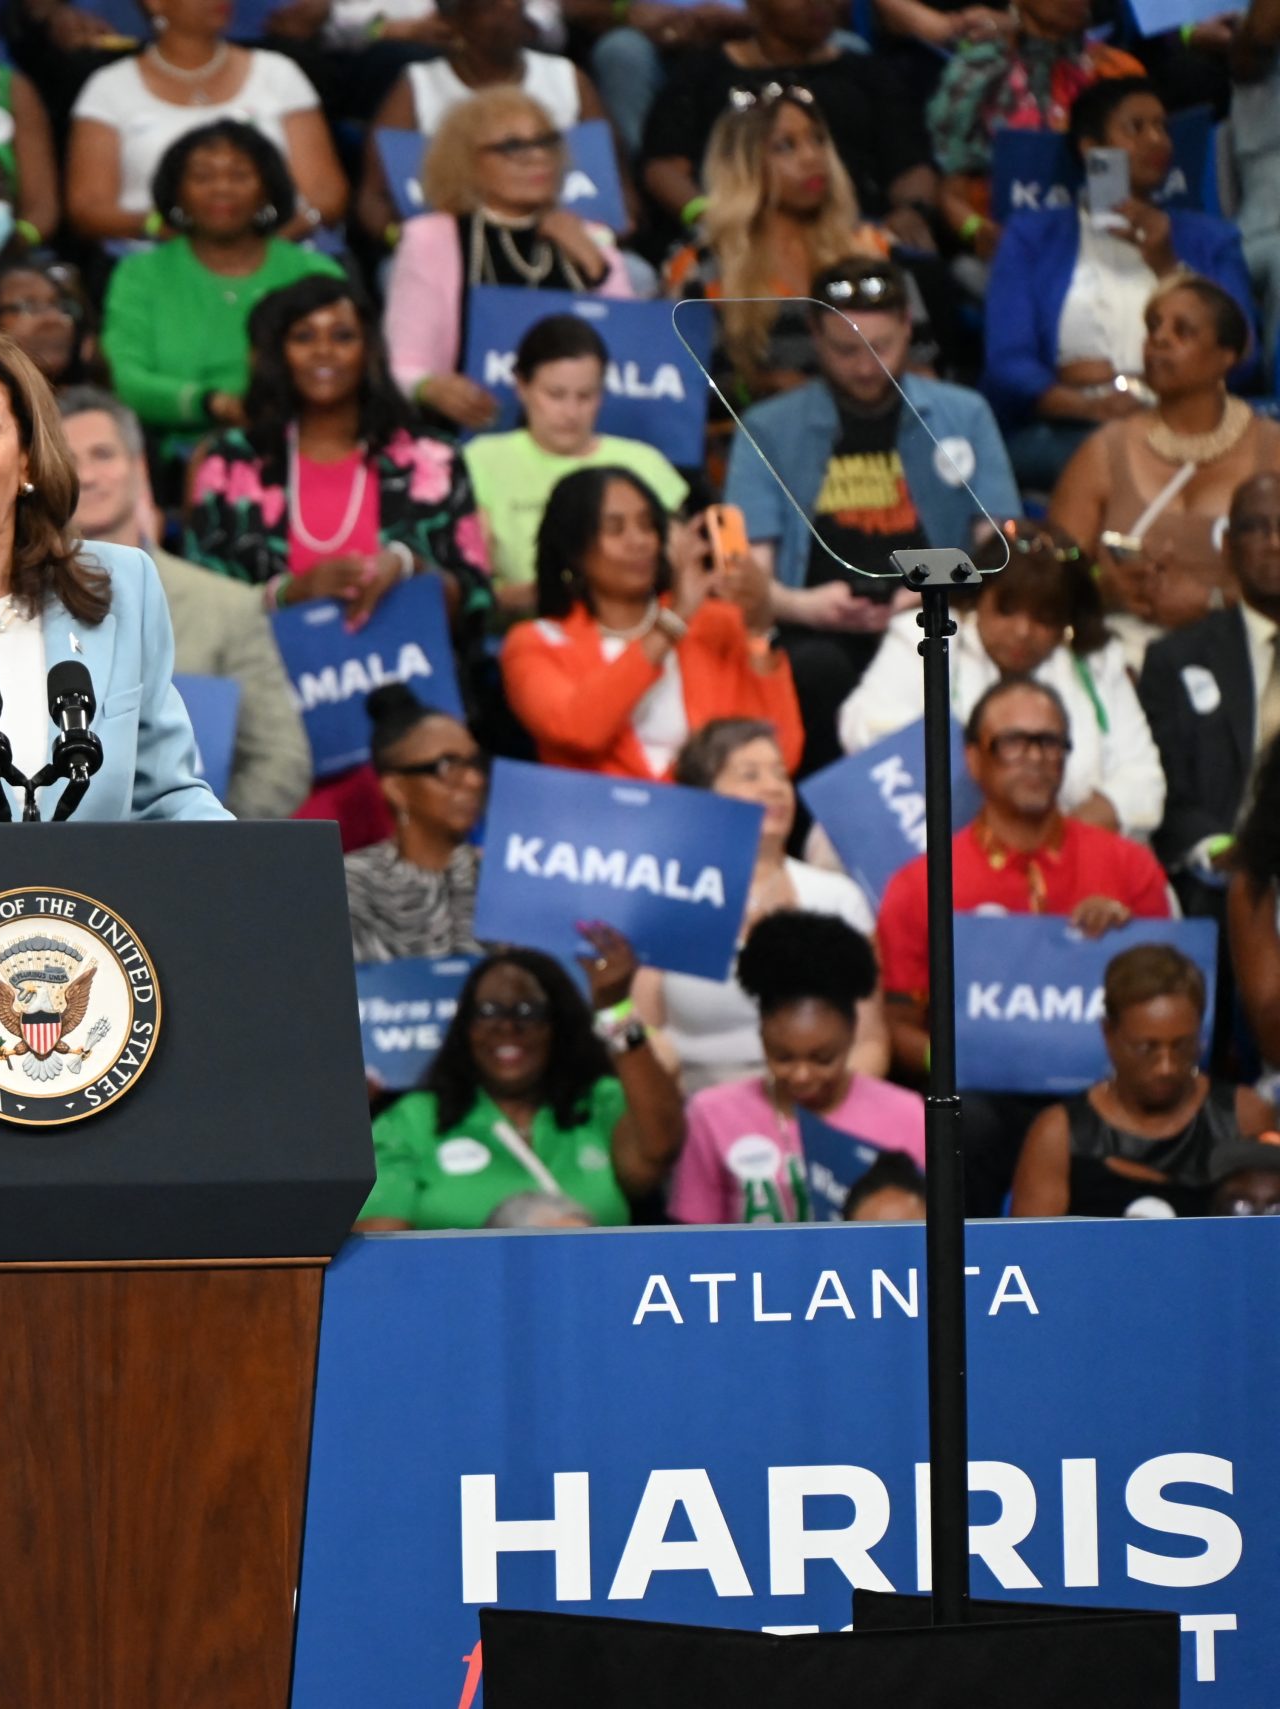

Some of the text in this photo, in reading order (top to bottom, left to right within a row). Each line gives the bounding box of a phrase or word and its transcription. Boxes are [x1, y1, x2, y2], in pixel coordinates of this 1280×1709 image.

[505, 833, 726, 909] KAMALA
[0, 899, 25, 919] OF
[35, 897, 77, 918] THE
[88, 908, 154, 1003] UNITED
[967, 981, 1107, 1024] KAMA
[84, 1020, 154, 1107] STATES
[372, 1024, 442, 1052] WE
[631, 1264, 1040, 1326] ATLANA
[460, 1452, 1244, 1604] HARRIS
